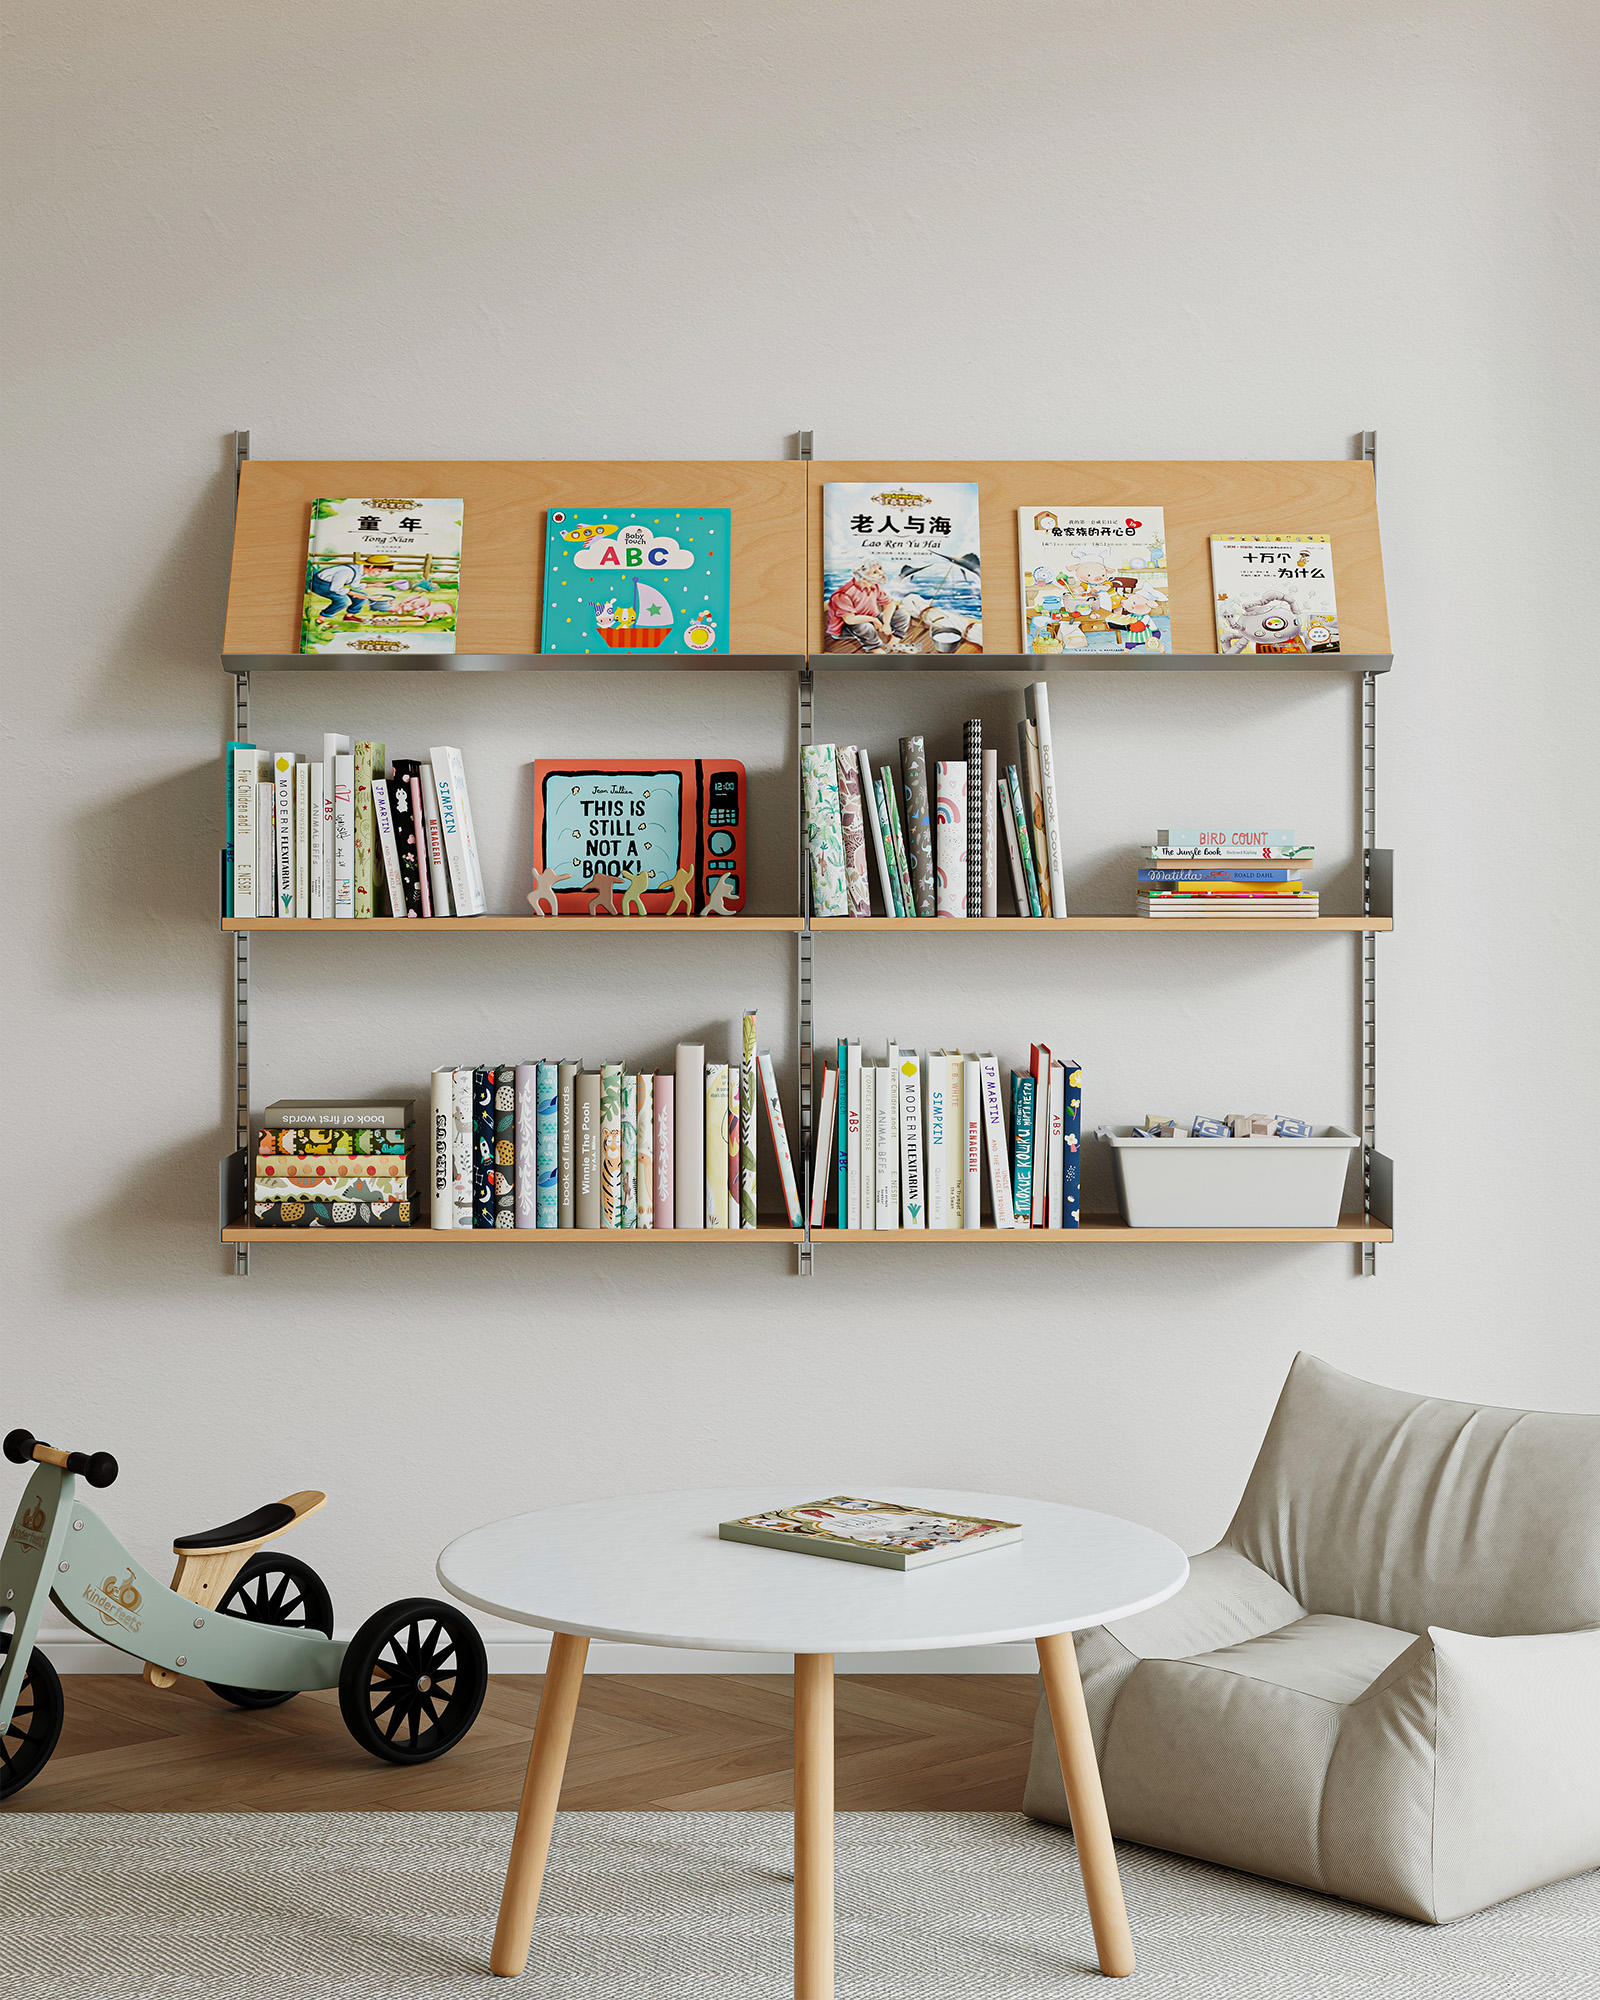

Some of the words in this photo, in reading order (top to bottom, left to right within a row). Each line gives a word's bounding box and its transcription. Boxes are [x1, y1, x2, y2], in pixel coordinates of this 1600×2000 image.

[357, 515, 422, 532] 童年
[850, 514, 952, 535] 老人与海
[361, 535, 387, 544] Tong
[861, 539, 881, 548] Lao
[884, 540, 904, 549] Ren
[906, 540, 920, 548] Yu
[922, 540, 941, 549] Hai
[599, 546, 669, 567] ABC
[1242, 552, 1291, 564] 十万个
[1277, 568, 1325, 579] 为什么
[1043, 744, 1051, 779] Baby
[238, 769, 251, 783] Five
[715, 782, 735, 790] 12:00
[238, 785, 251, 812] Children
[375, 786, 383, 796] JP
[591, 786, 608, 795] Jean
[279, 779, 289, 833] MODERN
[324, 799, 333, 821] ABS
[438, 781, 456, 834] SIMPKIN
[580, 800, 623, 817] THIS
[630, 800, 645, 817] IS
[1046, 786, 1055, 822] book
[238, 815, 251, 827] and
[377, 798, 390, 835] MARTIN
[589, 819, 635, 836] STILL
[429, 819, 442, 866] MENAGERIE
[586, 839, 622, 857] NOT
[627, 840, 639, 857] A
[1231, 832, 1269, 845] COUNT
[281, 836, 290, 890] FLEXITARIAN
[312, 843, 320, 865] BFFs
[1050, 830, 1059, 874] Cover
[1162, 847, 1175, 856] The
[1176, 847, 1202, 859] Jungle
[394, 869, 402, 886] UNCLE
[453, 855, 462, 882] Quentin
[582, 860, 642, 879] BOOK!
[1147, 869, 1202, 881] Matilda
[238, 873, 251, 895] NESBIT
[392, 890, 401, 912] TROUBLE
[952, 1062, 959, 1070] E.
[952, 1072, 959, 1080] B.
[985, 1065, 995, 1078] JP
[562, 1086, 570, 1127] words
[905, 1084, 917, 1140] MODERN
[987, 1081, 1000, 1124] MARTIN
[282, 1115, 317, 1124] words
[319, 1115, 340, 1124] first
[342, 1115, 355, 1124] of
[358, 1115, 385, 1124] book
[582, 1102, 590, 1130] Pooh
[849, 1111, 859, 1133] ABS
[933, 1092, 943, 1145] SIMPKIN
[1053, 1115, 1061, 1136] ABS
[562, 1129, 570, 1153] first
[582, 1133, 590, 1154] The
[969, 1122, 978, 1173] MENAGERIE
[1016, 1129, 1032, 1168] КОШКИ
[435, 1114, 447, 1191] CIRCUS
[562, 1156, 570, 1170] of
[839, 1151, 848, 1172] ABC
[878, 1151, 887, 1174] BFFs
[582, 1156, 590, 1195] Winnie
[907, 1143, 918, 1200] FLEXITARIAN
[995, 1168, 1003, 1193] TREACLE
[1002, 1170, 1010, 1190] UNCLE
[562, 1174, 570, 1206] book
[1015, 1171, 1031, 1212] ПЛОХИЕ
[998, 1195, 1006, 1222] TROUBLE
[12, 1525, 46, 1549] kinderfeets
[82, 1583, 142, 1633] kinderfeets
